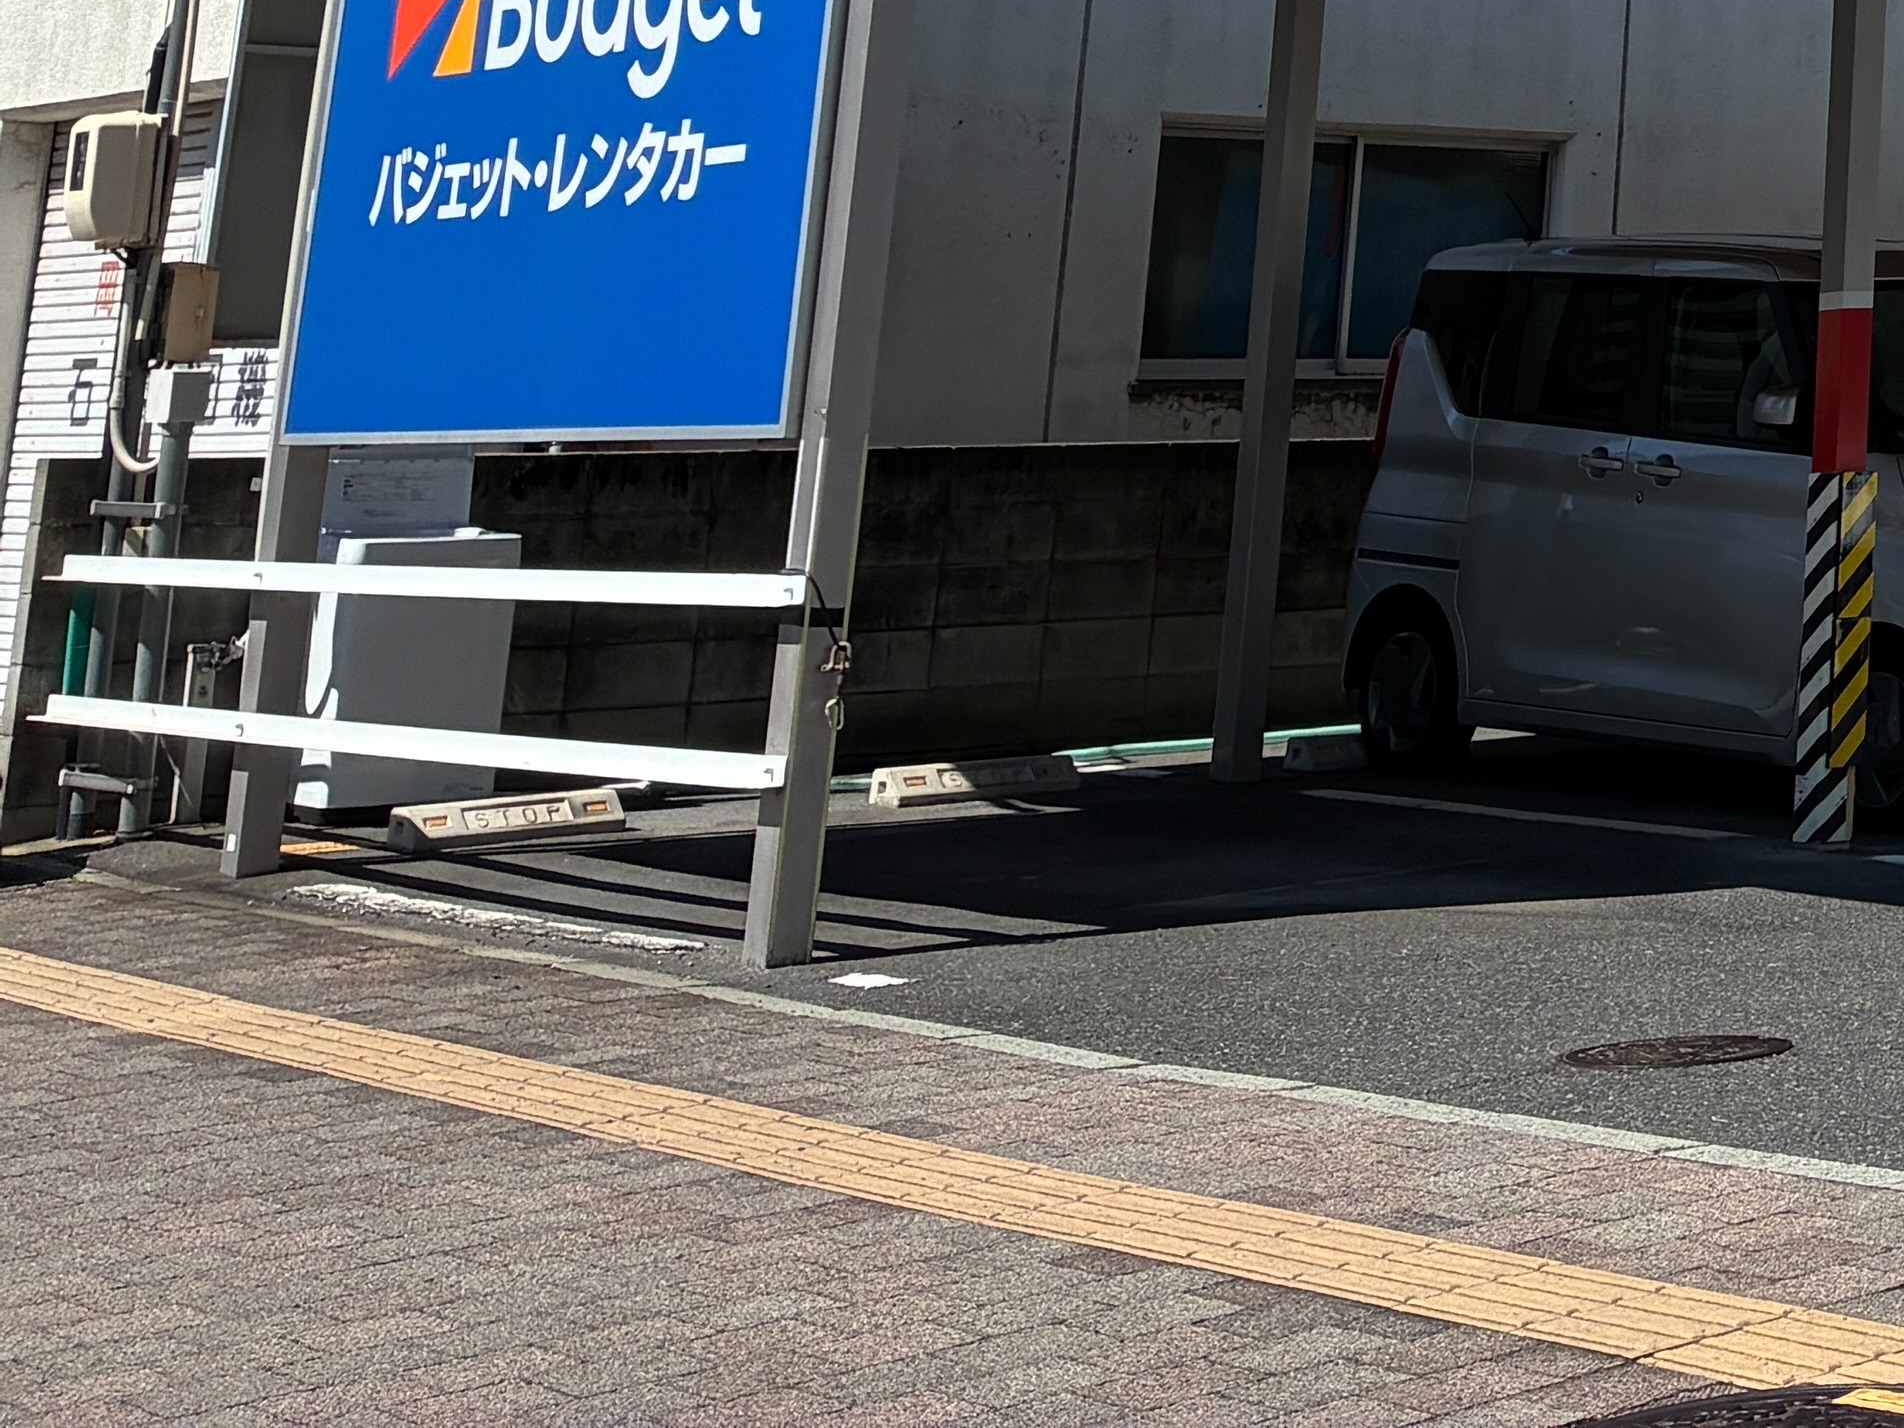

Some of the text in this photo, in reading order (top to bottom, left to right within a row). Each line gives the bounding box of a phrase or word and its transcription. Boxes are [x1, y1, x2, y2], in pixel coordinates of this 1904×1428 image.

[367, 118, 748, 228] バジェット・レンタカー
[473, 806, 561, 829] STOP
